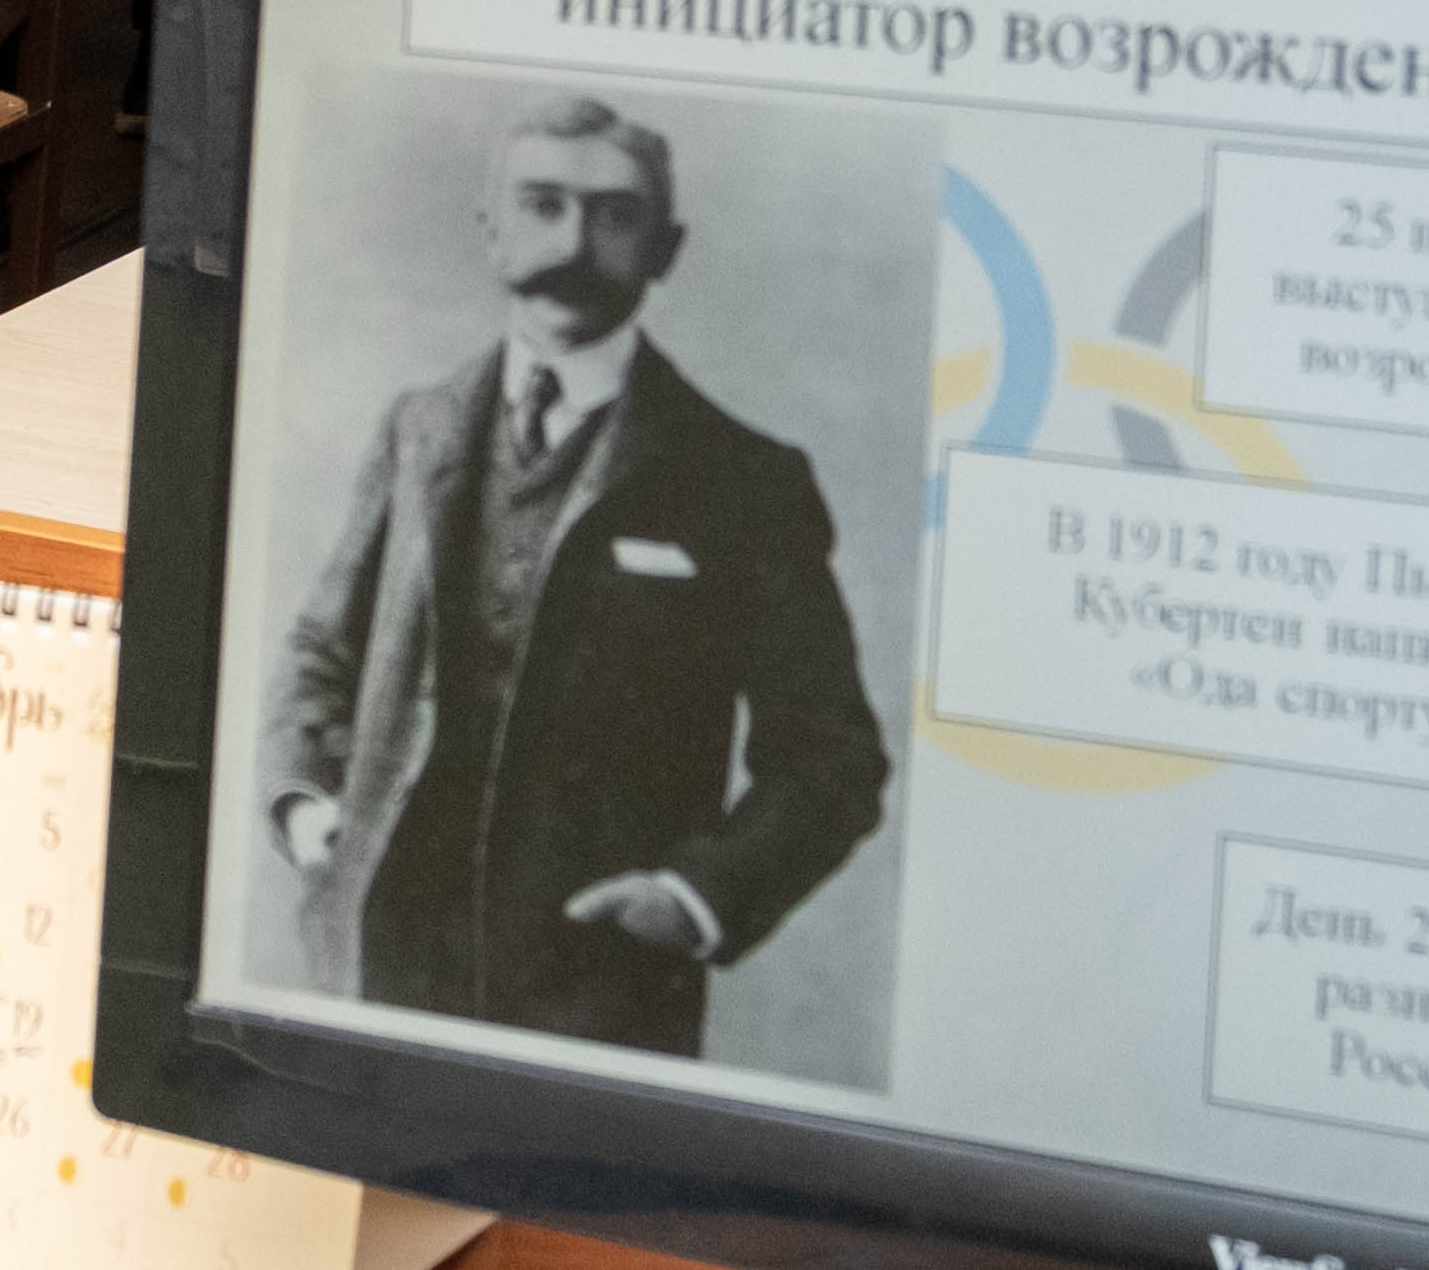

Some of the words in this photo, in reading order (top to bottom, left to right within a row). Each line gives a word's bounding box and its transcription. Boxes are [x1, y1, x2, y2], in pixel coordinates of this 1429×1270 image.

[1334, 200, 1395, 249] 25
[1046, 506, 1086, 555] В
[1106, 514, 1219, 574] 1912
[1236, 538, 1344, 596] году
[1072, 572, 1304, 655] Кубертен
[1129, 658, 1256, 712] «Ода
[40, 811, 62, 853] 5
[22, 903, 54, 948] 12
[1250, 886, 1387, 949] День
[12, 996, 45, 1042] 19
